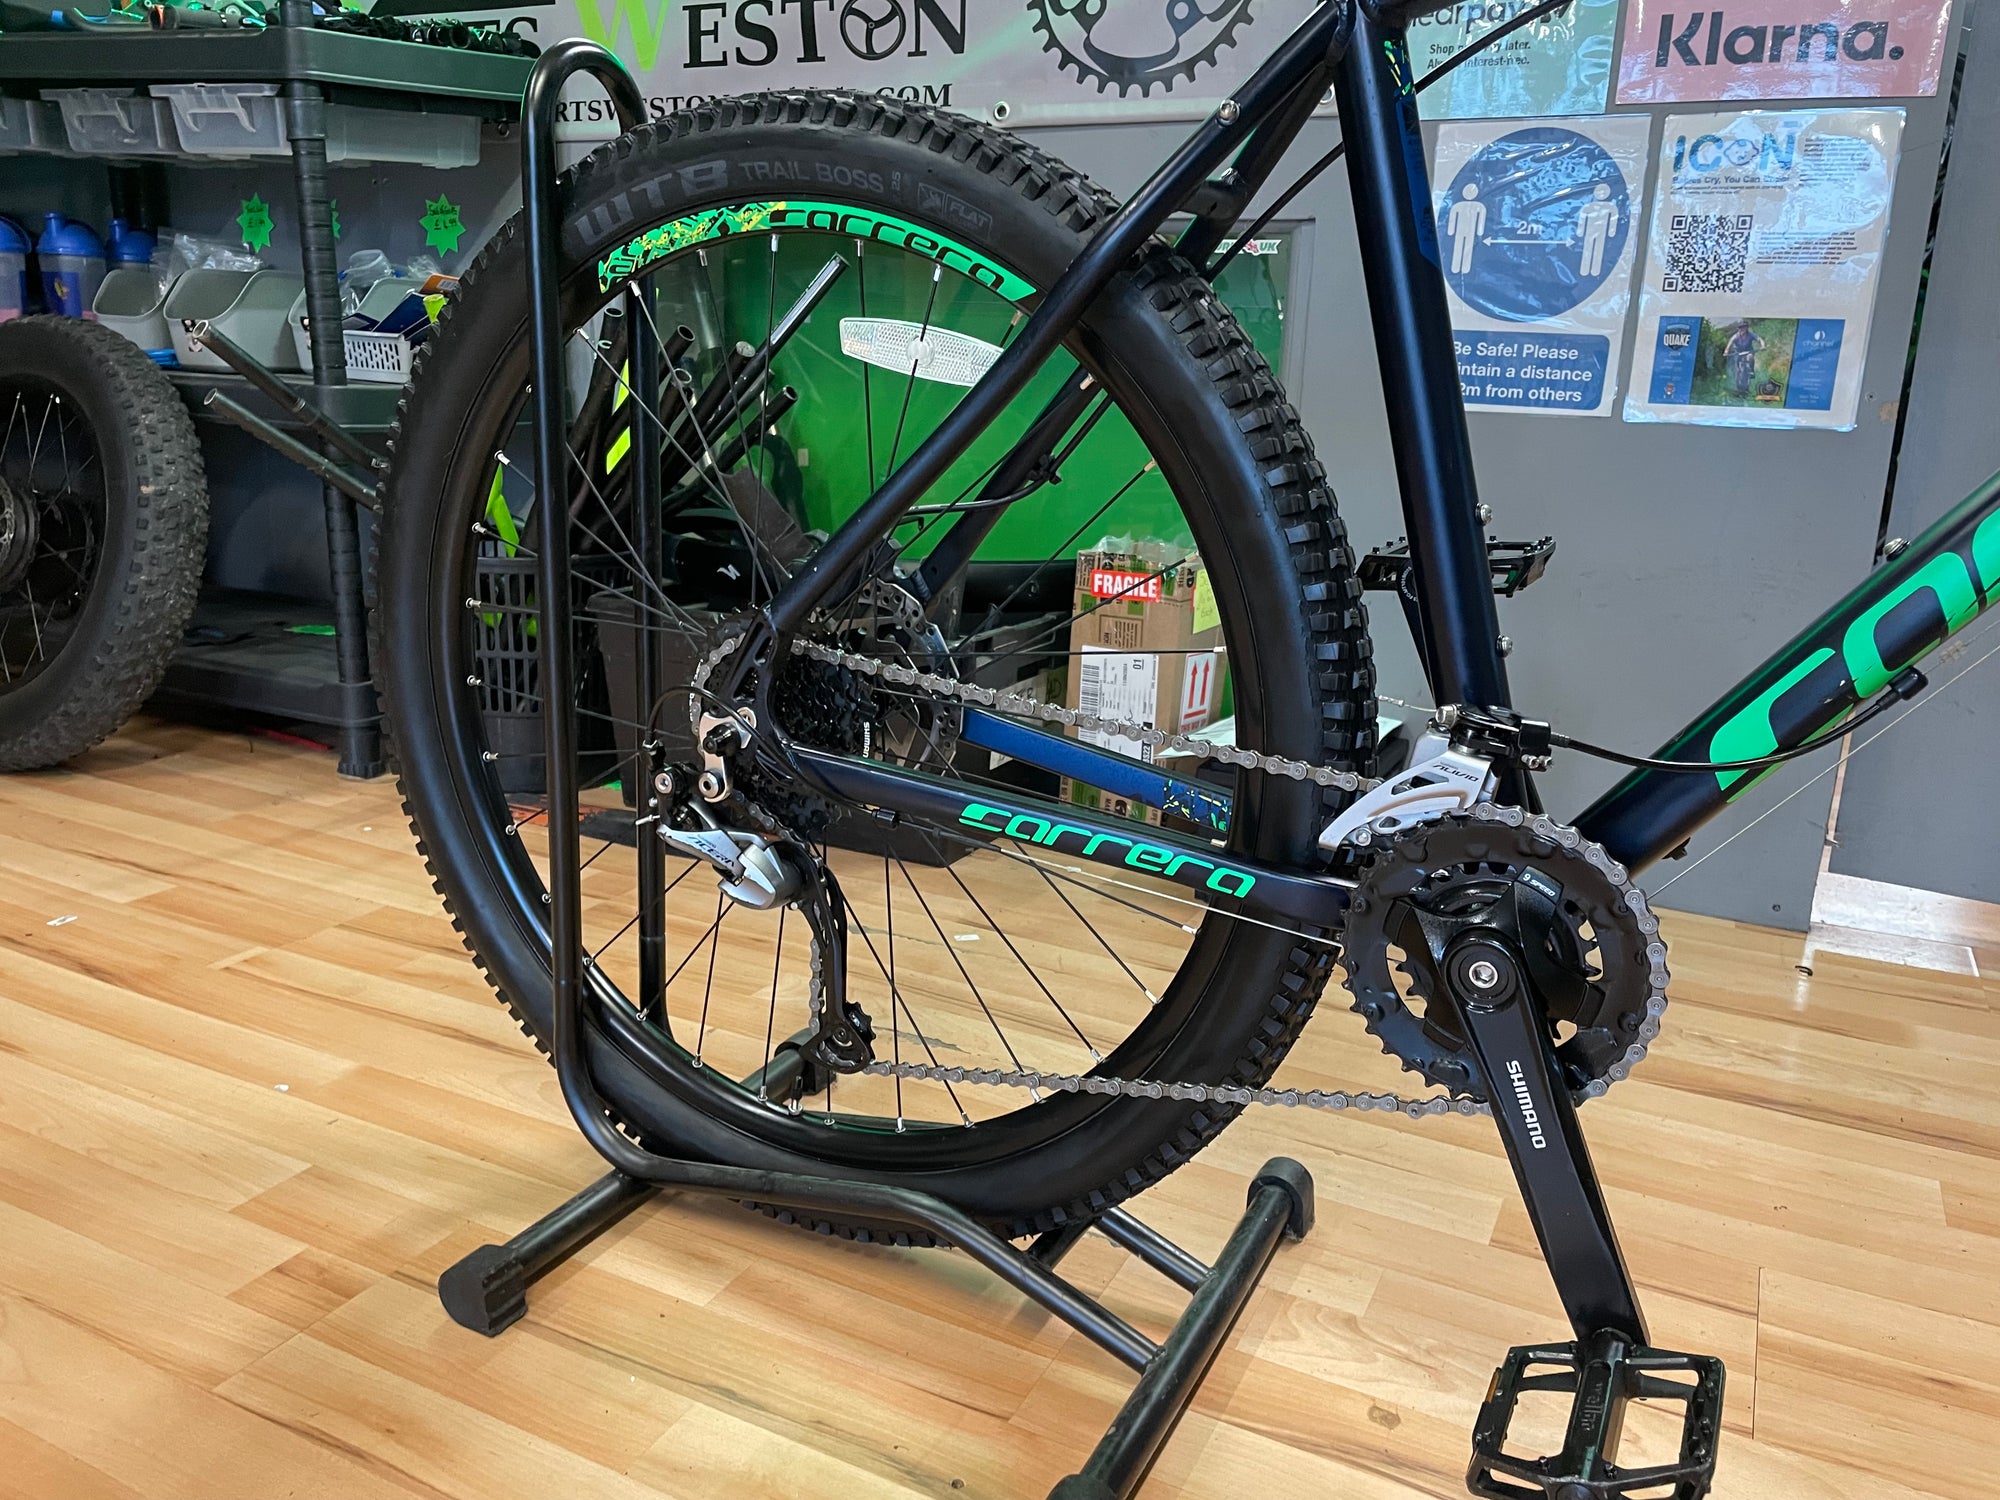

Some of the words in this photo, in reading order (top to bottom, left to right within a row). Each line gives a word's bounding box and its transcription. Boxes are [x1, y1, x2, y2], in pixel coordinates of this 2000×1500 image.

[1429, 44, 1454, 55] Shop
[1505, 40, 1531, 51] later.
[1655, 11, 1904, 68] Klarna.
[574, 160, 728, 246] WTB
[738, 161, 810, 181] TRAIL
[815, 163, 884, 193] BOSS
[1517, 221, 1542, 235] 2m
[769, 208, 1005, 292] carrera
[1260, 242, 1276, 251] UK
[1663, 333, 1691, 346] QUAKE
[1476, 342, 1518, 357] Safe!
[1522, 344, 1579, 360] Please
[1457, 362, 1501, 377] intain
[1505, 367, 1516, 378] a
[1520, 365, 1593, 381] distance
[1485, 384, 1524, 399] from
[1528, 387, 1583, 402] others
[1093, 573, 1158, 599] FRAGILE
[958, 803, 1256, 898] carrera
[1522, 873, 1532, 882] 9
[1529, 879, 1556, 897] SPEED
[1505, 1060, 1547, 1150] SHIMANO
